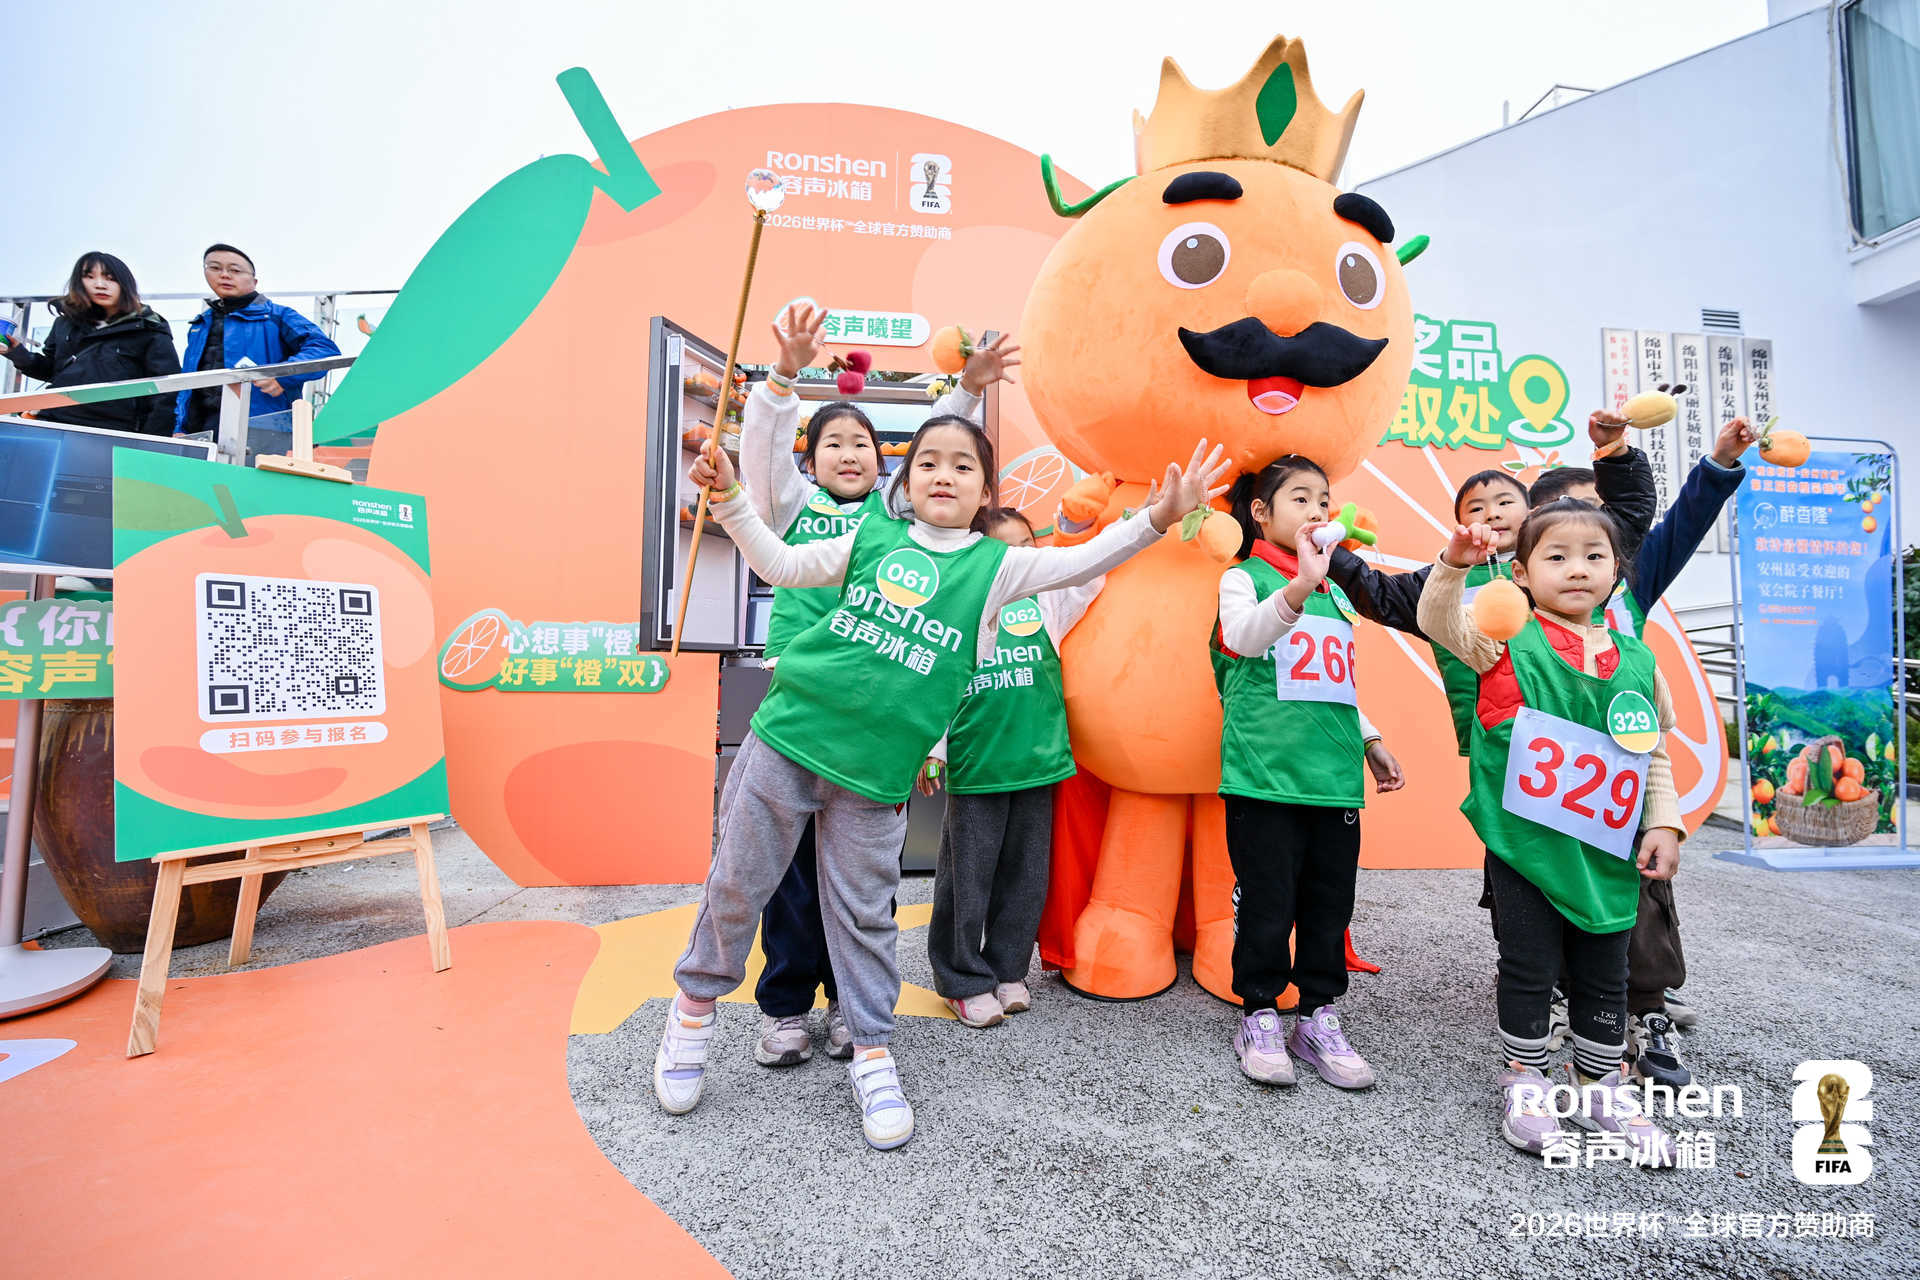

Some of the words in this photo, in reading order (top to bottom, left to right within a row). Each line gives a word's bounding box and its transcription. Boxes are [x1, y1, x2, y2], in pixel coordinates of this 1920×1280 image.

[766, 150, 887, 178] Ronshen
[782, 175, 873, 202] 容声冰箱
[921, 200, 941, 209] FIFA
[821, 314, 913, 340] 容声曦望
[795, 516, 860, 535] Rons
[886, 563, 930, 594] 061
[1757, 561, 1850, 580] 安州最受欢迎的
[1004, 607, 1039, 625] 062
[829, 609, 938, 676] 容声冰箱
[1613, 711, 1651, 733] 329
[228, 726, 367, 749] 扫码参与报名
[1518, 736, 1640, 830] 329
